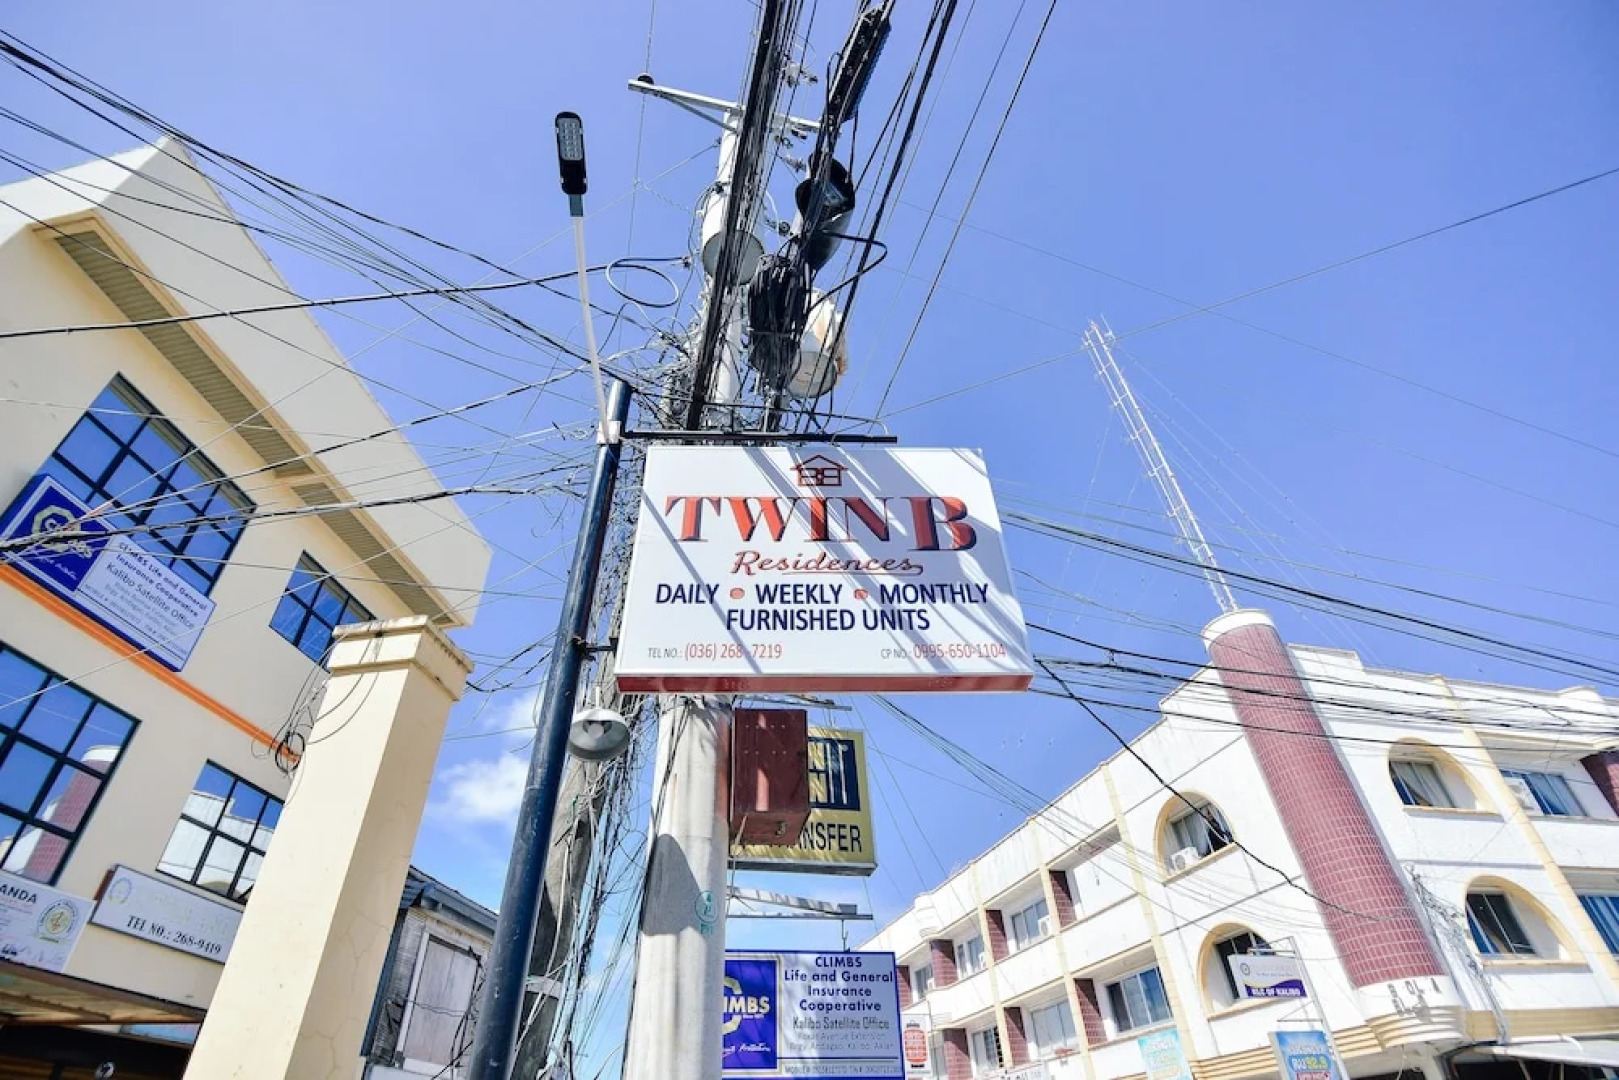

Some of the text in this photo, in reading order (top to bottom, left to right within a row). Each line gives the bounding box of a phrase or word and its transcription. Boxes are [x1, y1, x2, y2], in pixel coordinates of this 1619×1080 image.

[729, 550, 924, 576] Residences
[116, 554, 155, 585] Insurance
[155, 582, 199, 617] Cooperative
[149, 564, 163, 578] Life
[163, 577, 179, 590] and
[179, 587, 208, 611] General
[656, 583, 989, 605] DAILY WEEKLY MONTHLY
[106, 562, 136, 587] Kalibo
[136, 584, 171, 612] Satellite
[170, 609, 195, 630] Office
[726, 609, 930, 631] FURNISHED UNITS
[647, 647, 662, 658] TEL
[684, 642, 717, 661] (036)
[880, 648, 892, 660] CP
[914, 643, 1006, 660] 0995-650-1104
[799, 822, 862, 852] NSFER
[126, 915, 146, 932] TEL
[815, 956, 863, 968] CLIMBS
[784, 969, 893, 982] Life and General
[807, 984, 872, 997] Insurance
[723, 996, 770, 1014] IMBS
[799, 999, 882, 1014] Cooperative
[793, 1015, 890, 1029] Kalibo Satellite Office
